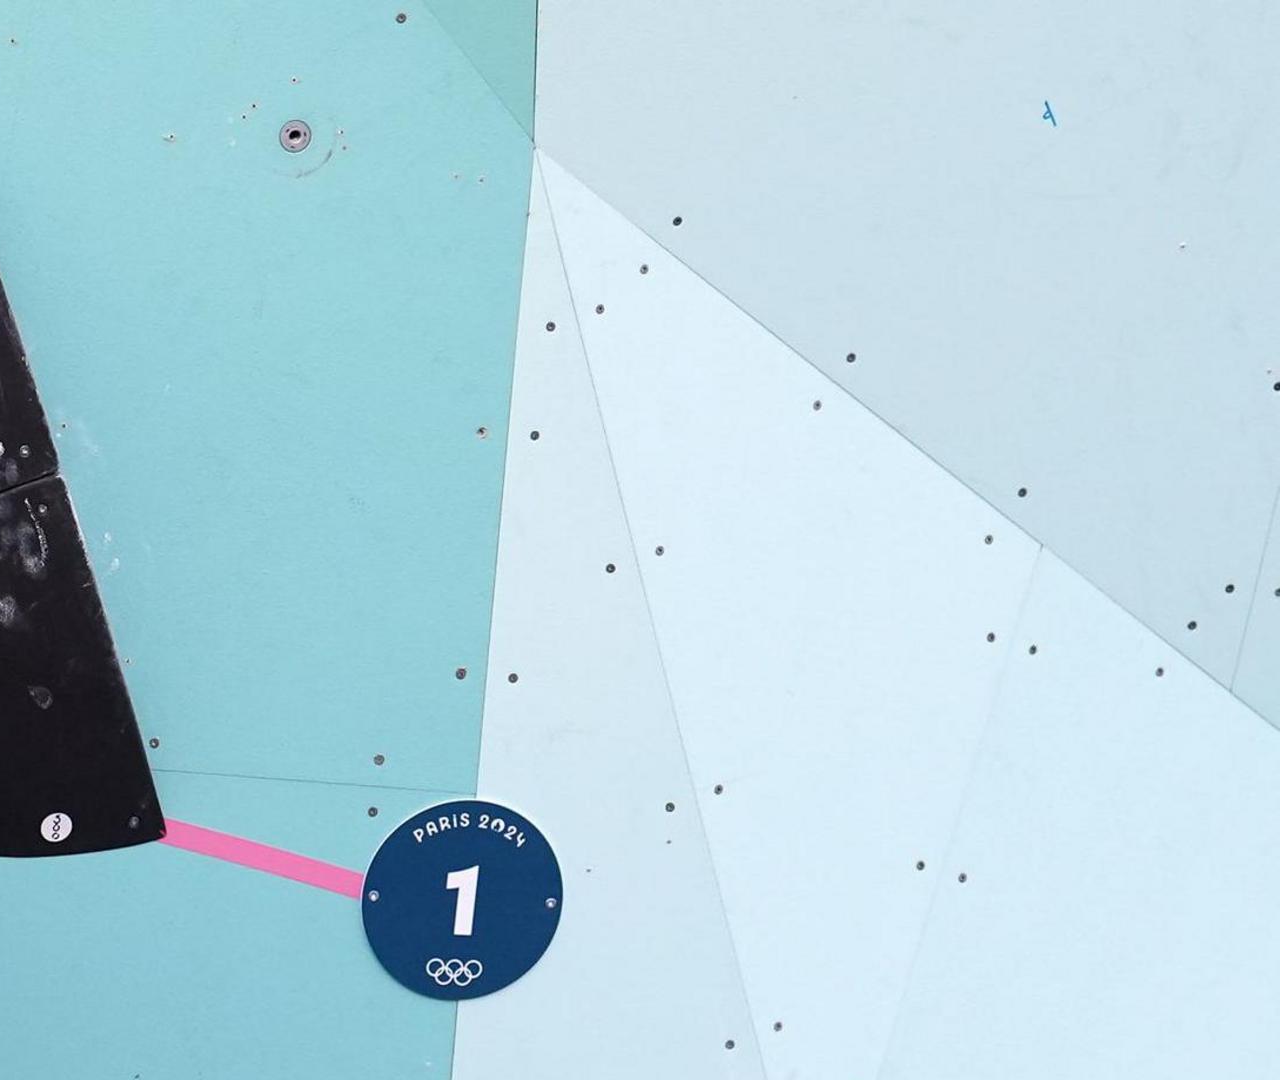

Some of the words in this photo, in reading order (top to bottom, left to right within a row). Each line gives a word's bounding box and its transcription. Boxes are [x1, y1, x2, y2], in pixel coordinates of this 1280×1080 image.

[412, 812, 470, 844] PARIS
[477, 814, 527, 848] 2024
[446, 864, 480, 937] 1
